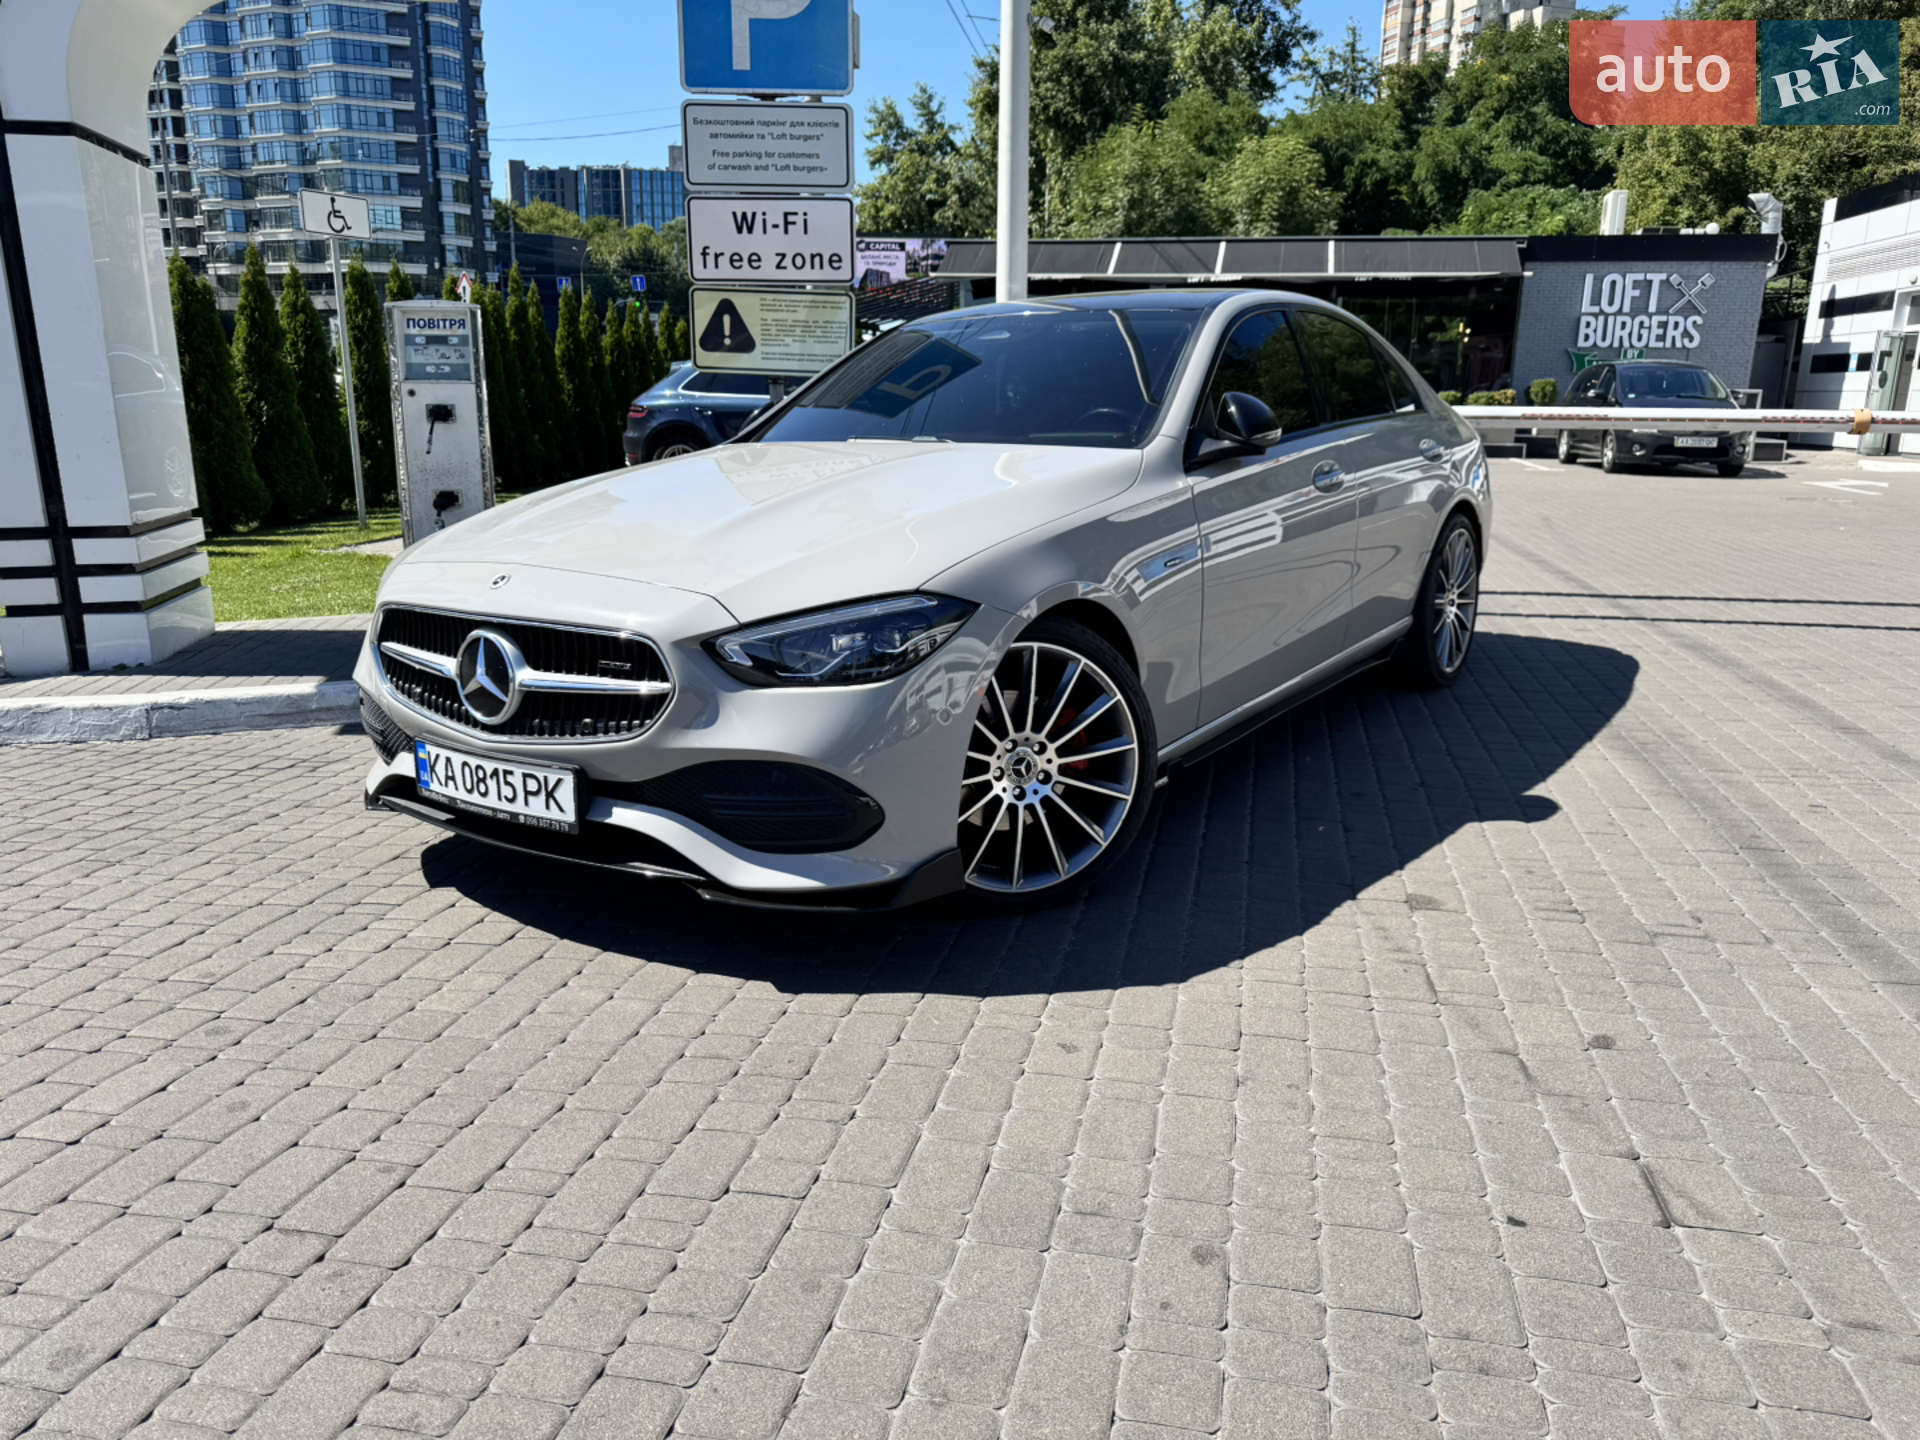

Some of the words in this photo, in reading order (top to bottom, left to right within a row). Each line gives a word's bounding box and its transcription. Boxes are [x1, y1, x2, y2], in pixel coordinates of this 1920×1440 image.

[692, 117, 755, 126] Безкоштовний
[756, 118, 788, 128] паркінг
[789, 120, 805, 128] для
[806, 120, 840, 128] клієнтів
[709, 131, 754, 140] автомийки
[712, 149, 730, 158] Free
[732, 150, 763, 160] parking
[764, 151, 776, 159] for
[777, 151, 820, 159] customers
[707, 162, 716, 171] of
[717, 163, 752, 171] carwash
[754, 163, 770, 172] and
[731, 210, 809, 236] Wi-Fi
[700, 245, 762, 270] free
[775, 251, 843, 271] zone
[1581, 273, 1667, 313] LOFT
[406, 317, 466, 329] ПОВІТРЯ
[1577, 315, 1703, 348] BURGERS
[1627, 349, 1639, 359] BY
